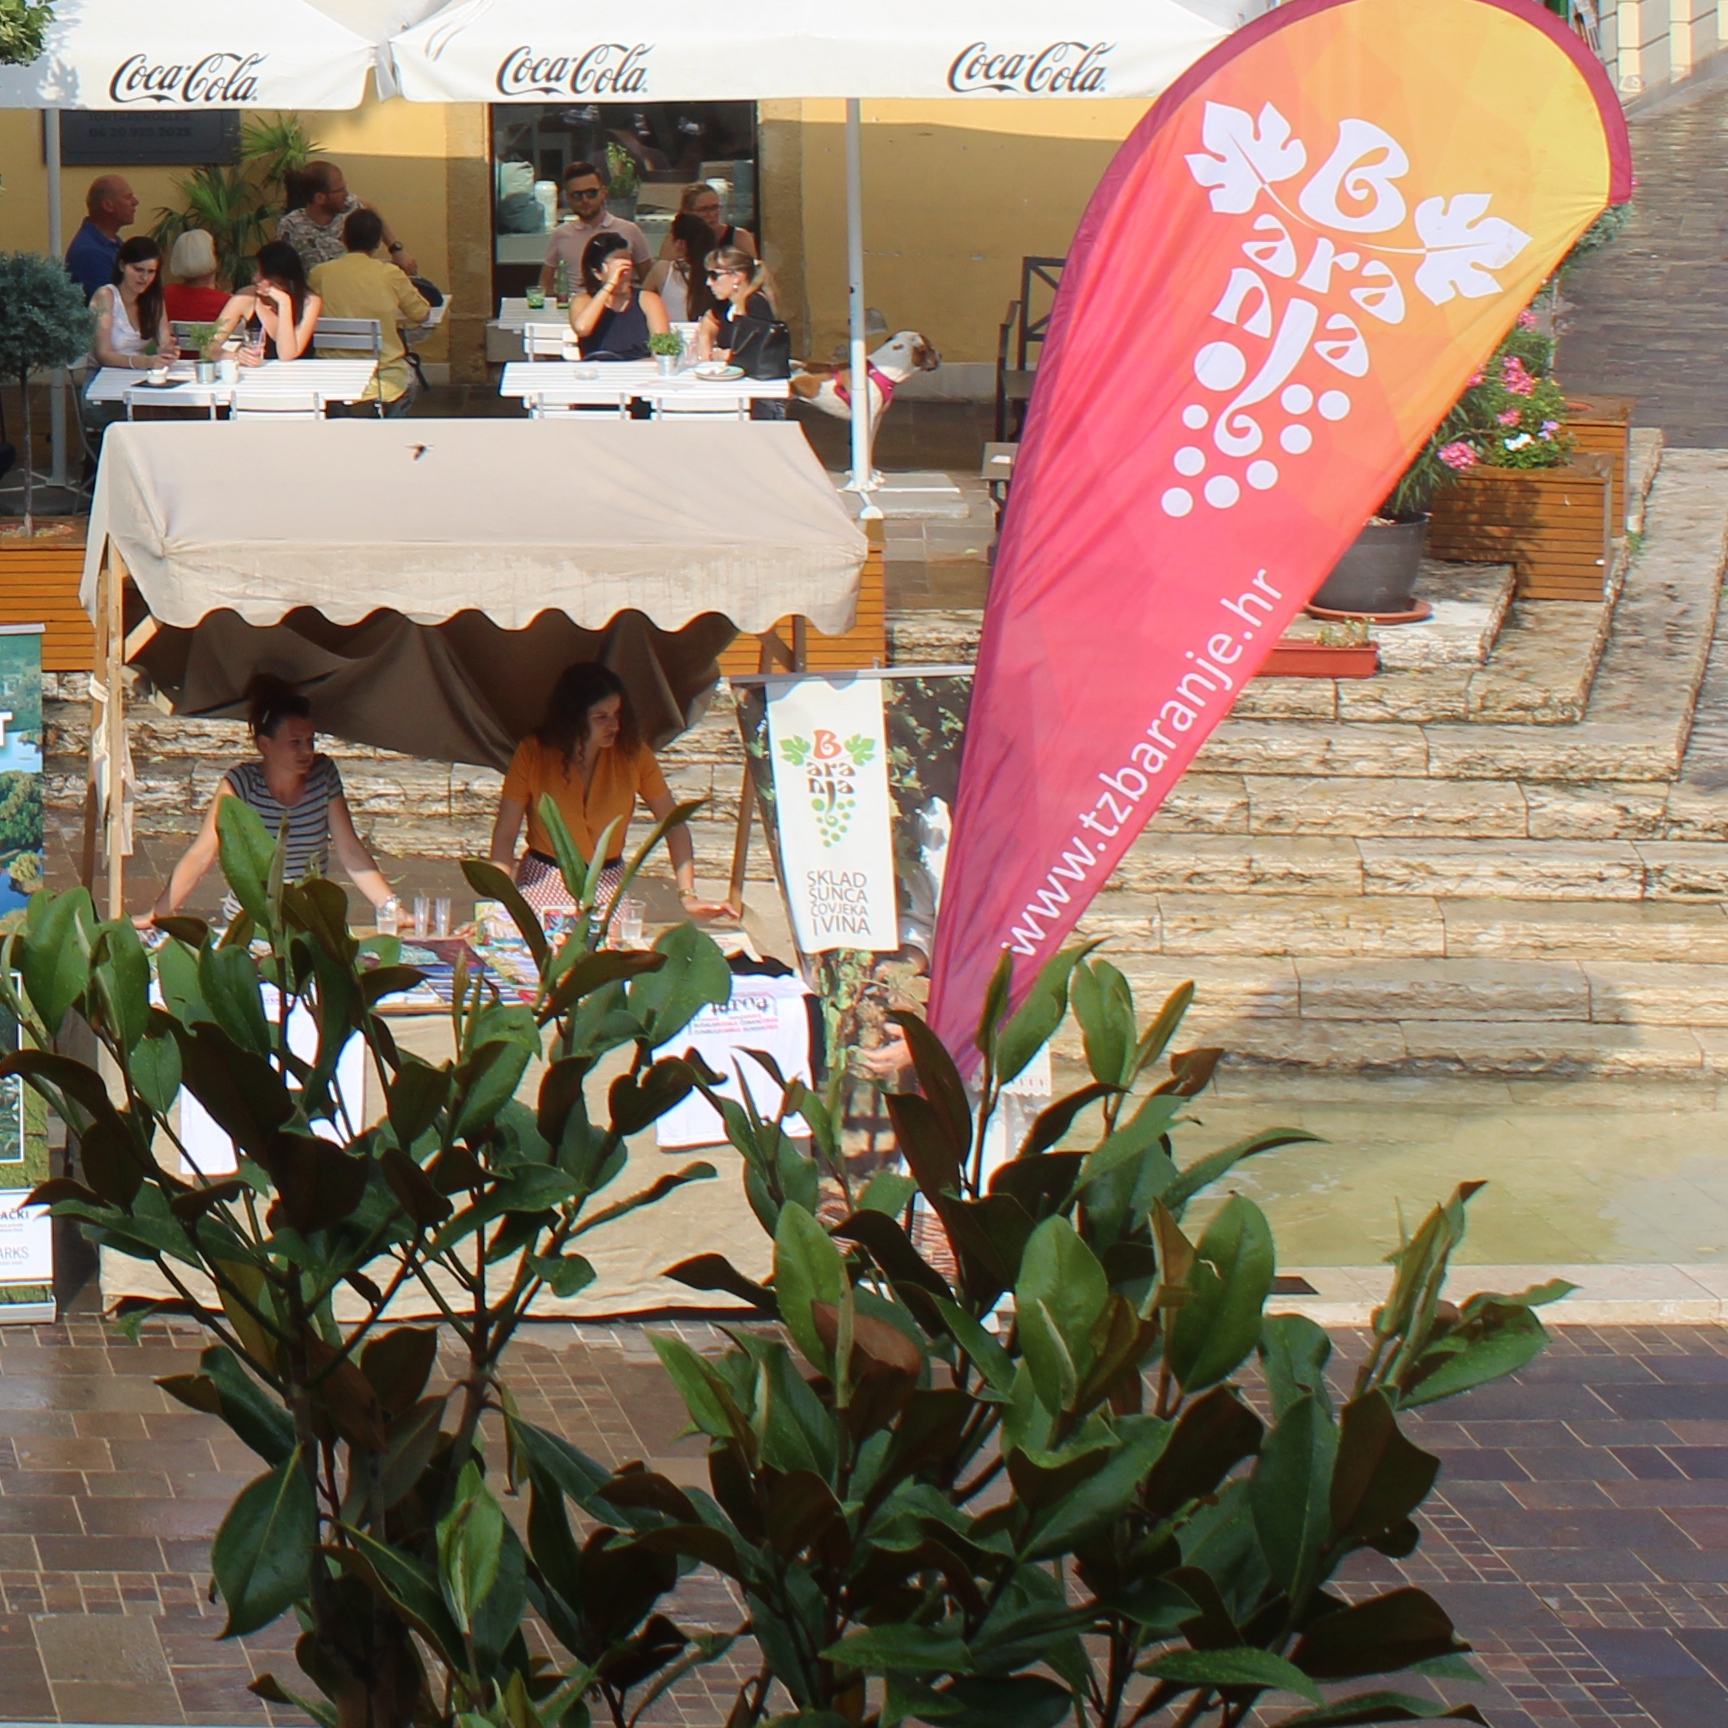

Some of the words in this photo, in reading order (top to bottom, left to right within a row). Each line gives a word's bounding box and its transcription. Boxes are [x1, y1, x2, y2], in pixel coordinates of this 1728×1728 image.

[109, 51, 270, 105] Coca-Cola
[496, 42, 656, 97] Coca-Cola
[947, 41, 1119, 94] Coca-Cola
[1001, 568, 1283, 957] www.tzbaranje.hr
[807, 870, 868, 889] SKLAD
[810, 901, 869, 918] ČOVJEKA
[820, 914, 872, 936] VINA
